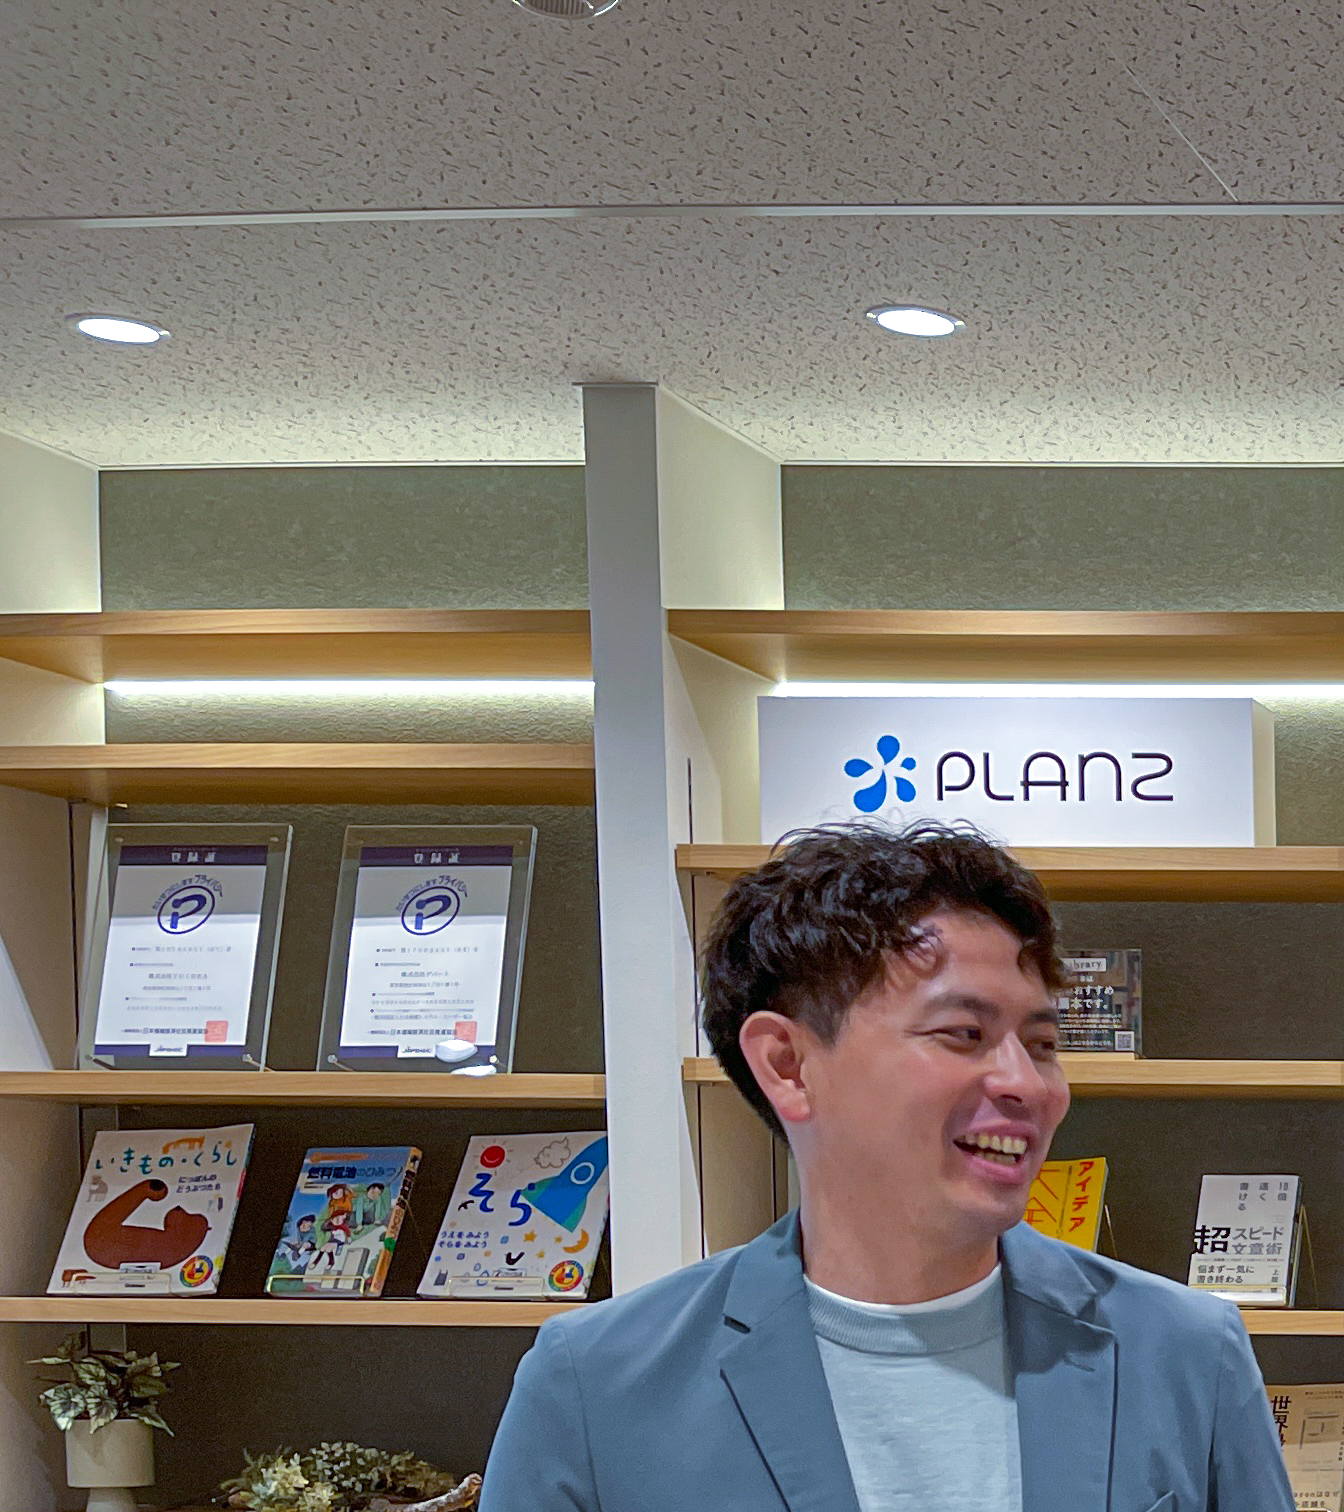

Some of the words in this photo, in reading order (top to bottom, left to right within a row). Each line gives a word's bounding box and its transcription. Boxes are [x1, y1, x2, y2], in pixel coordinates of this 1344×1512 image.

[936, 750, 1174, 801] PLANZ
[95, 1143, 238, 1175] いきもの・くらし
[1069, 1160, 1095, 1233] アイデア
[1194, 1224, 1232, 1255] 超
[1232, 1226, 1284, 1241] スピード
[1231, 1242, 1283, 1255] 文章術
